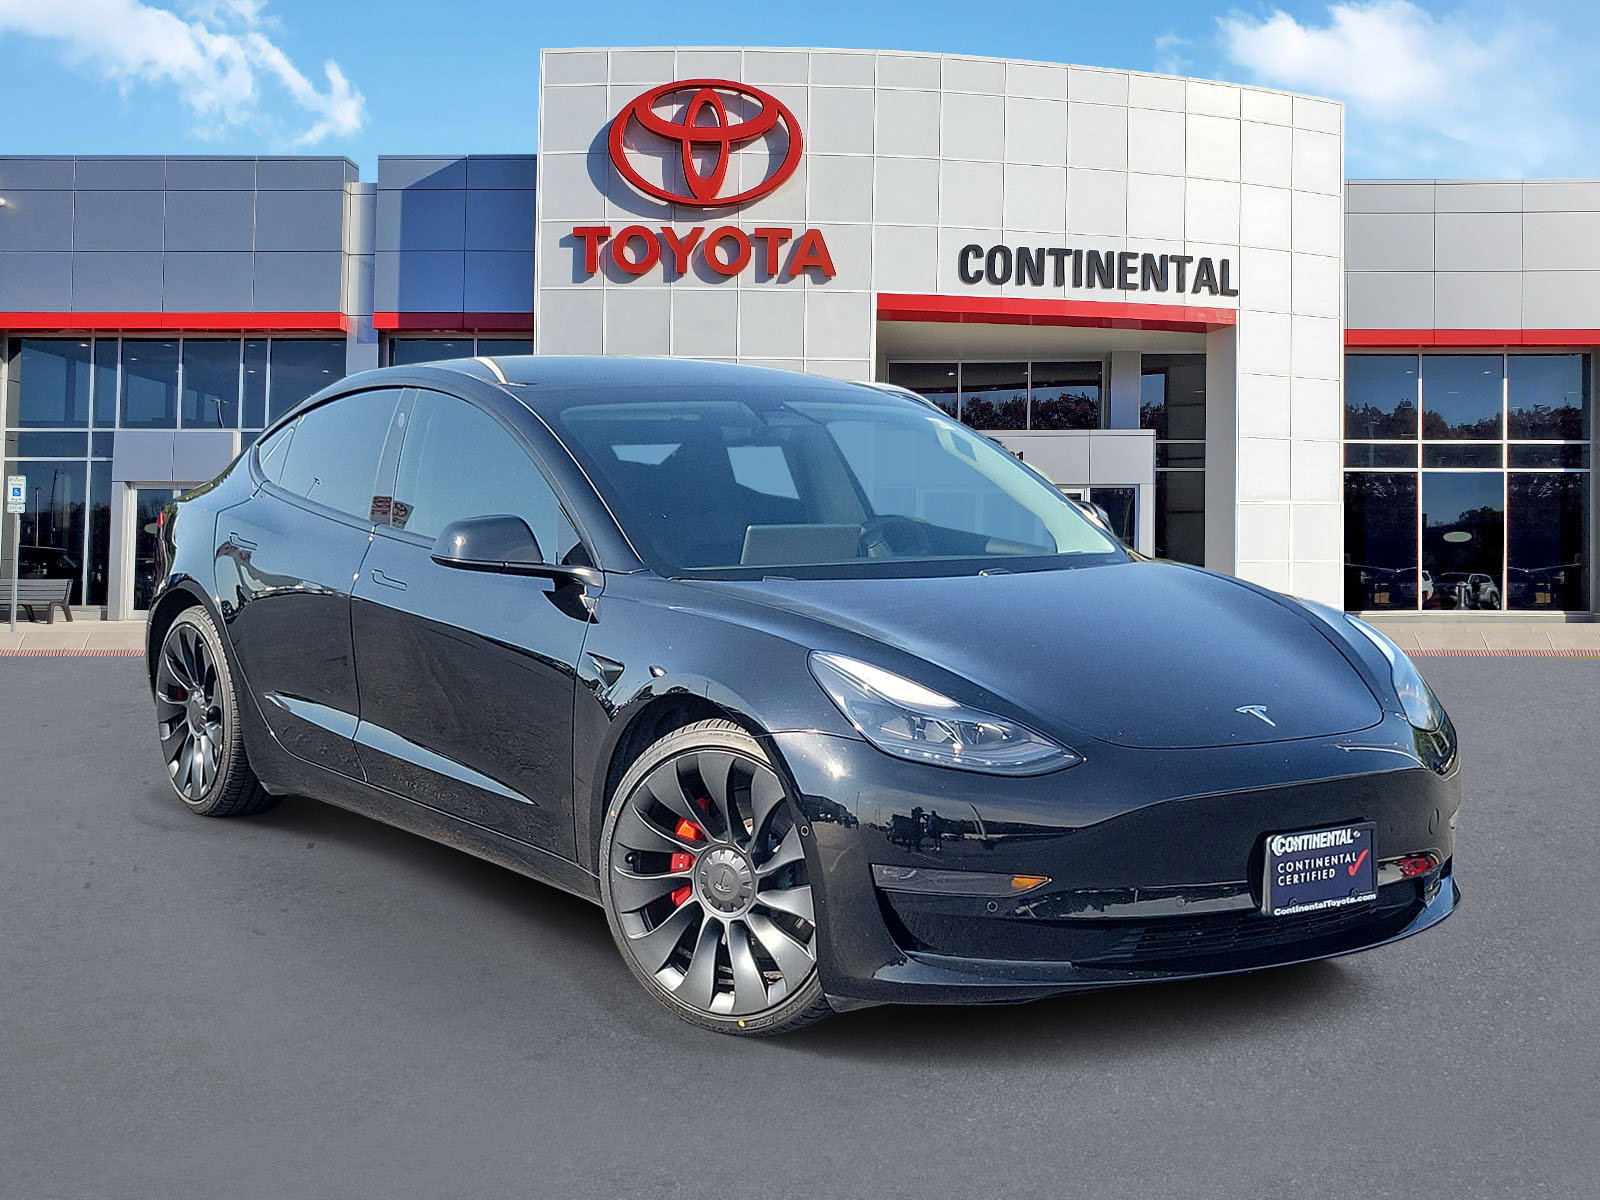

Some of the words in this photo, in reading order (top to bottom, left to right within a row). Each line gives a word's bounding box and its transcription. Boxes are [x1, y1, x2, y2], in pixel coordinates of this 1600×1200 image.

[572, 225, 837, 277] TOYOTA
[958, 244, 1239, 297] CONTINENTAL
[1271, 828, 1354, 856] CONTINENTAL
[1277, 852, 1357, 873] CONTINENTAL
[1277, 868, 1336, 886] CERTIFIED
[1273, 893, 1377, 916] ContinentalToyota.com
